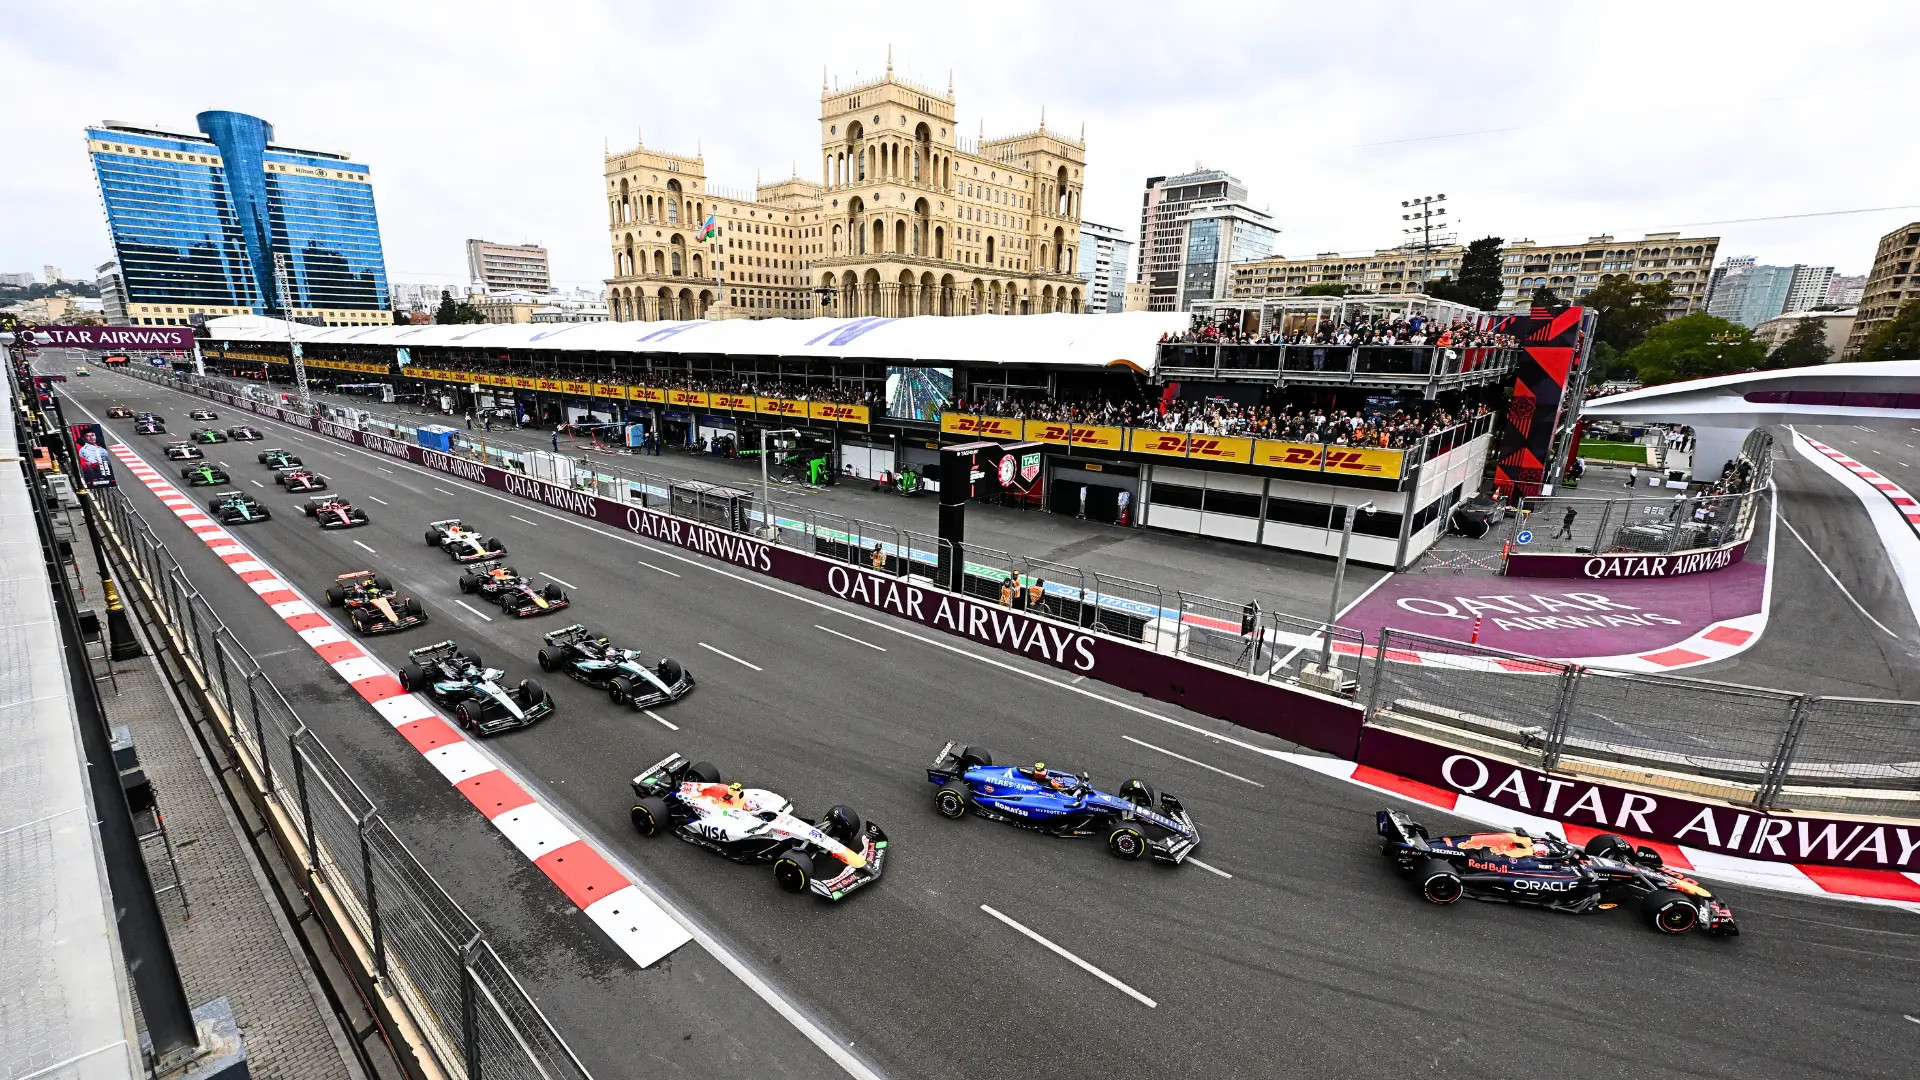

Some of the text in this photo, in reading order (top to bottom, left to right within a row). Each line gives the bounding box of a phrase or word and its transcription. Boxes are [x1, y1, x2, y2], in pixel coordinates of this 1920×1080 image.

[295, 167, 314, 175] Hilton
[99, 331, 182, 344] AIRWAYS
[517, 379, 532, 387] DHL
[541, 381, 558, 390] DHL
[568, 384, 585, 393] DHL
[600, 387, 617, 396] DHL
[637, 389, 656, 400] DHL
[677, 393, 700, 404] DHL
[719, 397, 744, 408] DHL
[767, 401, 796, 414] DHL
[822, 406, 856, 419] DHL
[957, 418, 1003, 433] DHL
[1045, 427, 1098, 443] DHL
[362, 434, 410, 460] QATAR AIRWAYS
[1157, 436, 1222, 456] DHL
[1024, 456, 1039, 466] TAG
[1283, 448, 1366, 469] DHL
[422, 450, 486, 483] QATAR AIRWAYS
[505, 473, 596, 518] QATAR AIRWAYS
[627, 508, 682, 545] QATAR
[687, 525, 771, 572] AIRWAYS
[1584, 548, 1733, 578] QATAR AIRWAYS
[1396, 592, 1641, 620] QATAR
[828, 566, 1096, 671] QATAR AIRWAYS
[1490, 613, 1681, 631] AIRWAYS
[985, 776, 1027, 791] ATLASSIAN
[994, 801, 1029, 817] KOMATSU
[1442, 754, 1657, 834] QATAR
[1673, 807, 1920, 866] AIRWAY
[699, 823, 729, 841] VISA
[1442, 837, 1454, 847] 1
[1432, 848, 1466, 857] HONDA
[1468, 859, 1508, 873] Red Bull
[1514, 880, 1579, 892] ORACLE
